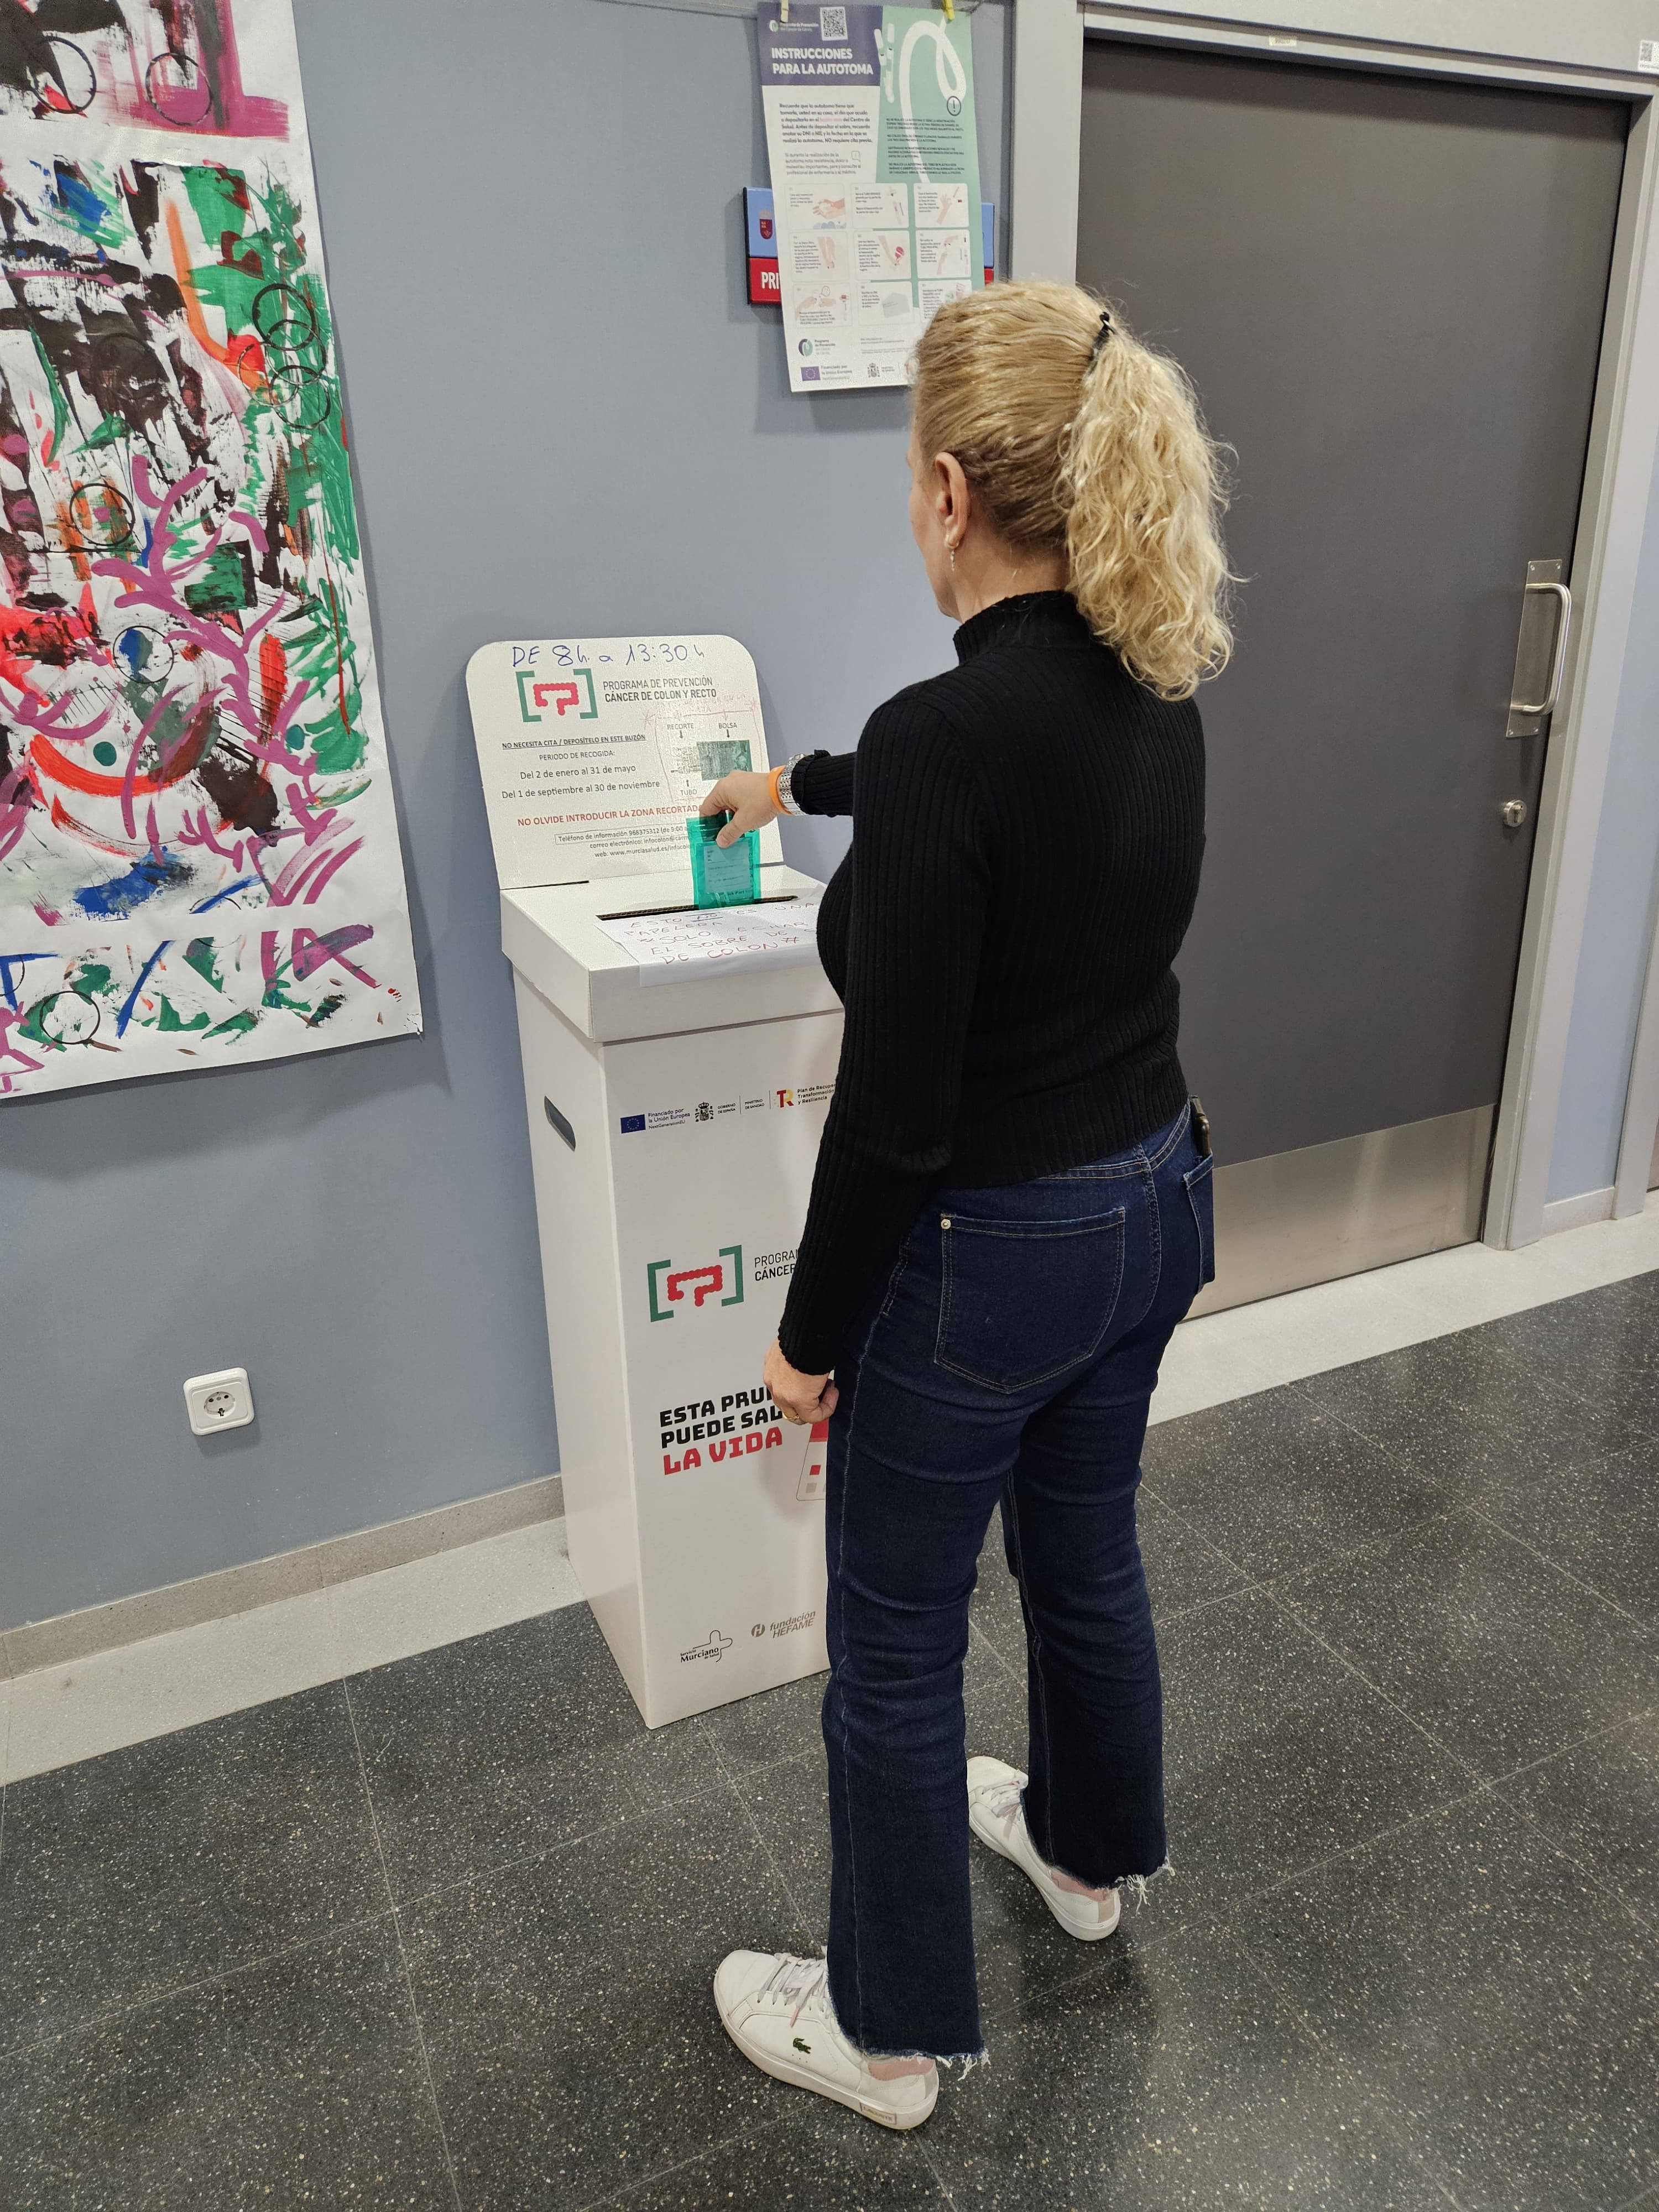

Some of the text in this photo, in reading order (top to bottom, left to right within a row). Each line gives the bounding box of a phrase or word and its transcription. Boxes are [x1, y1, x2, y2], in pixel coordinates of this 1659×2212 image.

[771, 48, 853, 59] INSTRUCCIONES
[773, 63, 874, 75] PARA LA AUTOTOMA
[512, 646, 540, 667] DE
[626, 644, 687, 665] 13:30
[603, 675, 713, 691] PROGRAMA DE PREVENCIÓN
[605, 688, 717, 702] CÁNCER DE COLON Y RECTO
[564, 737, 599, 745] DEPOSÍTELO
[539, 753, 568, 761] PERIODO
[520, 771, 534, 779] Del
[544, 769, 554, 778] de
[602, 765, 612, 774] de
[614, 765, 636, 775] mayo
[502, 790, 515, 799] Del
[525, 789, 535, 797] de
[538, 786, 583, 798] septiembre
[607, 782, 617, 791] de
[619, 780, 660, 791] noviembre
[534, 815, 564, 825] OLVIDE
[566, 811, 617, 822] INTRODUCIR
[619, 810, 629, 818] LA
[632, 808, 654, 816] ZONA
[559, 834, 584, 842] Teléfono
[594, 831, 628, 839] información
[610, 839, 643, 847] electrónico:
[644, 836, 690, 844] infocolon@carm
[610, 844, 691, 856] www.murciasalud.es/infocolo
[630, 919, 682, 927] ESTO
[651, 947, 674, 955] EL
[687, 935, 747, 948] SOBRE
[660, 952, 689, 964] DE
[707, 942, 778, 958] COLON
[797, 1088, 835, 1099] Transformación
[648, 1120, 686, 1129] NextGenerationEU
[754, 1249, 797, 1268] PROGRA
[660, 1386, 773, 1427] ESTA PRU
[661, 1405, 783, 1449] PUEDE SAL
[664, 1426, 782, 1475] LA VIDA
[770, 1611, 816, 1631] fundación
[772, 1618, 815, 1639] HEFAME
[680, 1647, 719, 1663] Murciano
